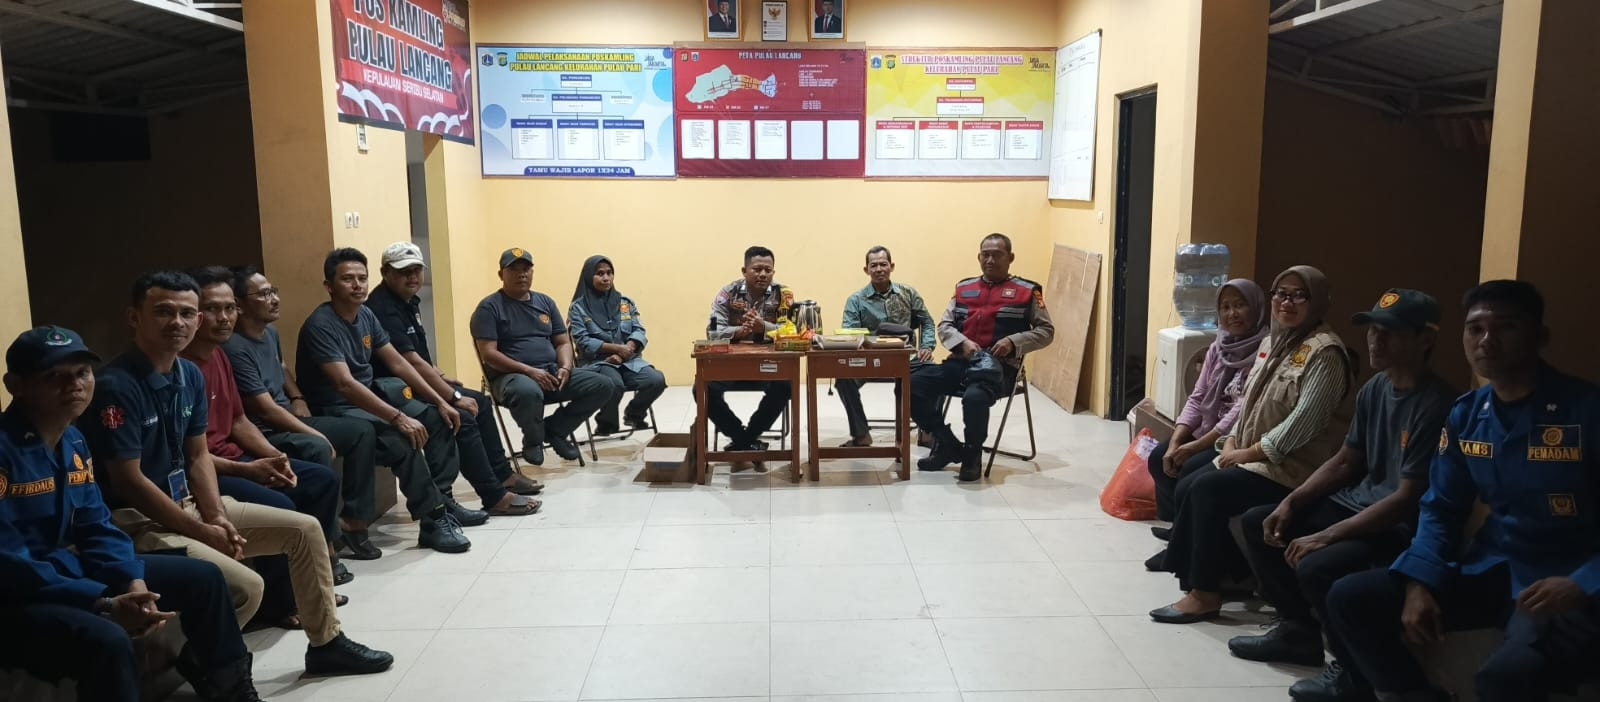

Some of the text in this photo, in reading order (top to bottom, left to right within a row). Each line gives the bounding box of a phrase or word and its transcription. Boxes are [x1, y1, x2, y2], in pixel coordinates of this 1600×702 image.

[388, 0, 445, 50] KAMLING
[347, 18, 453, 92] PULAU LANCANG
[591, 53, 635, 62] POSKAMLING
[510, 63, 531, 72] PULAU
[532, 63, 563, 72] LANCANG
[603, 63, 625, 72] PULAU
[363, 68, 401, 91] KEPULAUAN
[423, 86, 444, 104] SELATAN
[1528, 447, 1580, 460] PEMADAM
